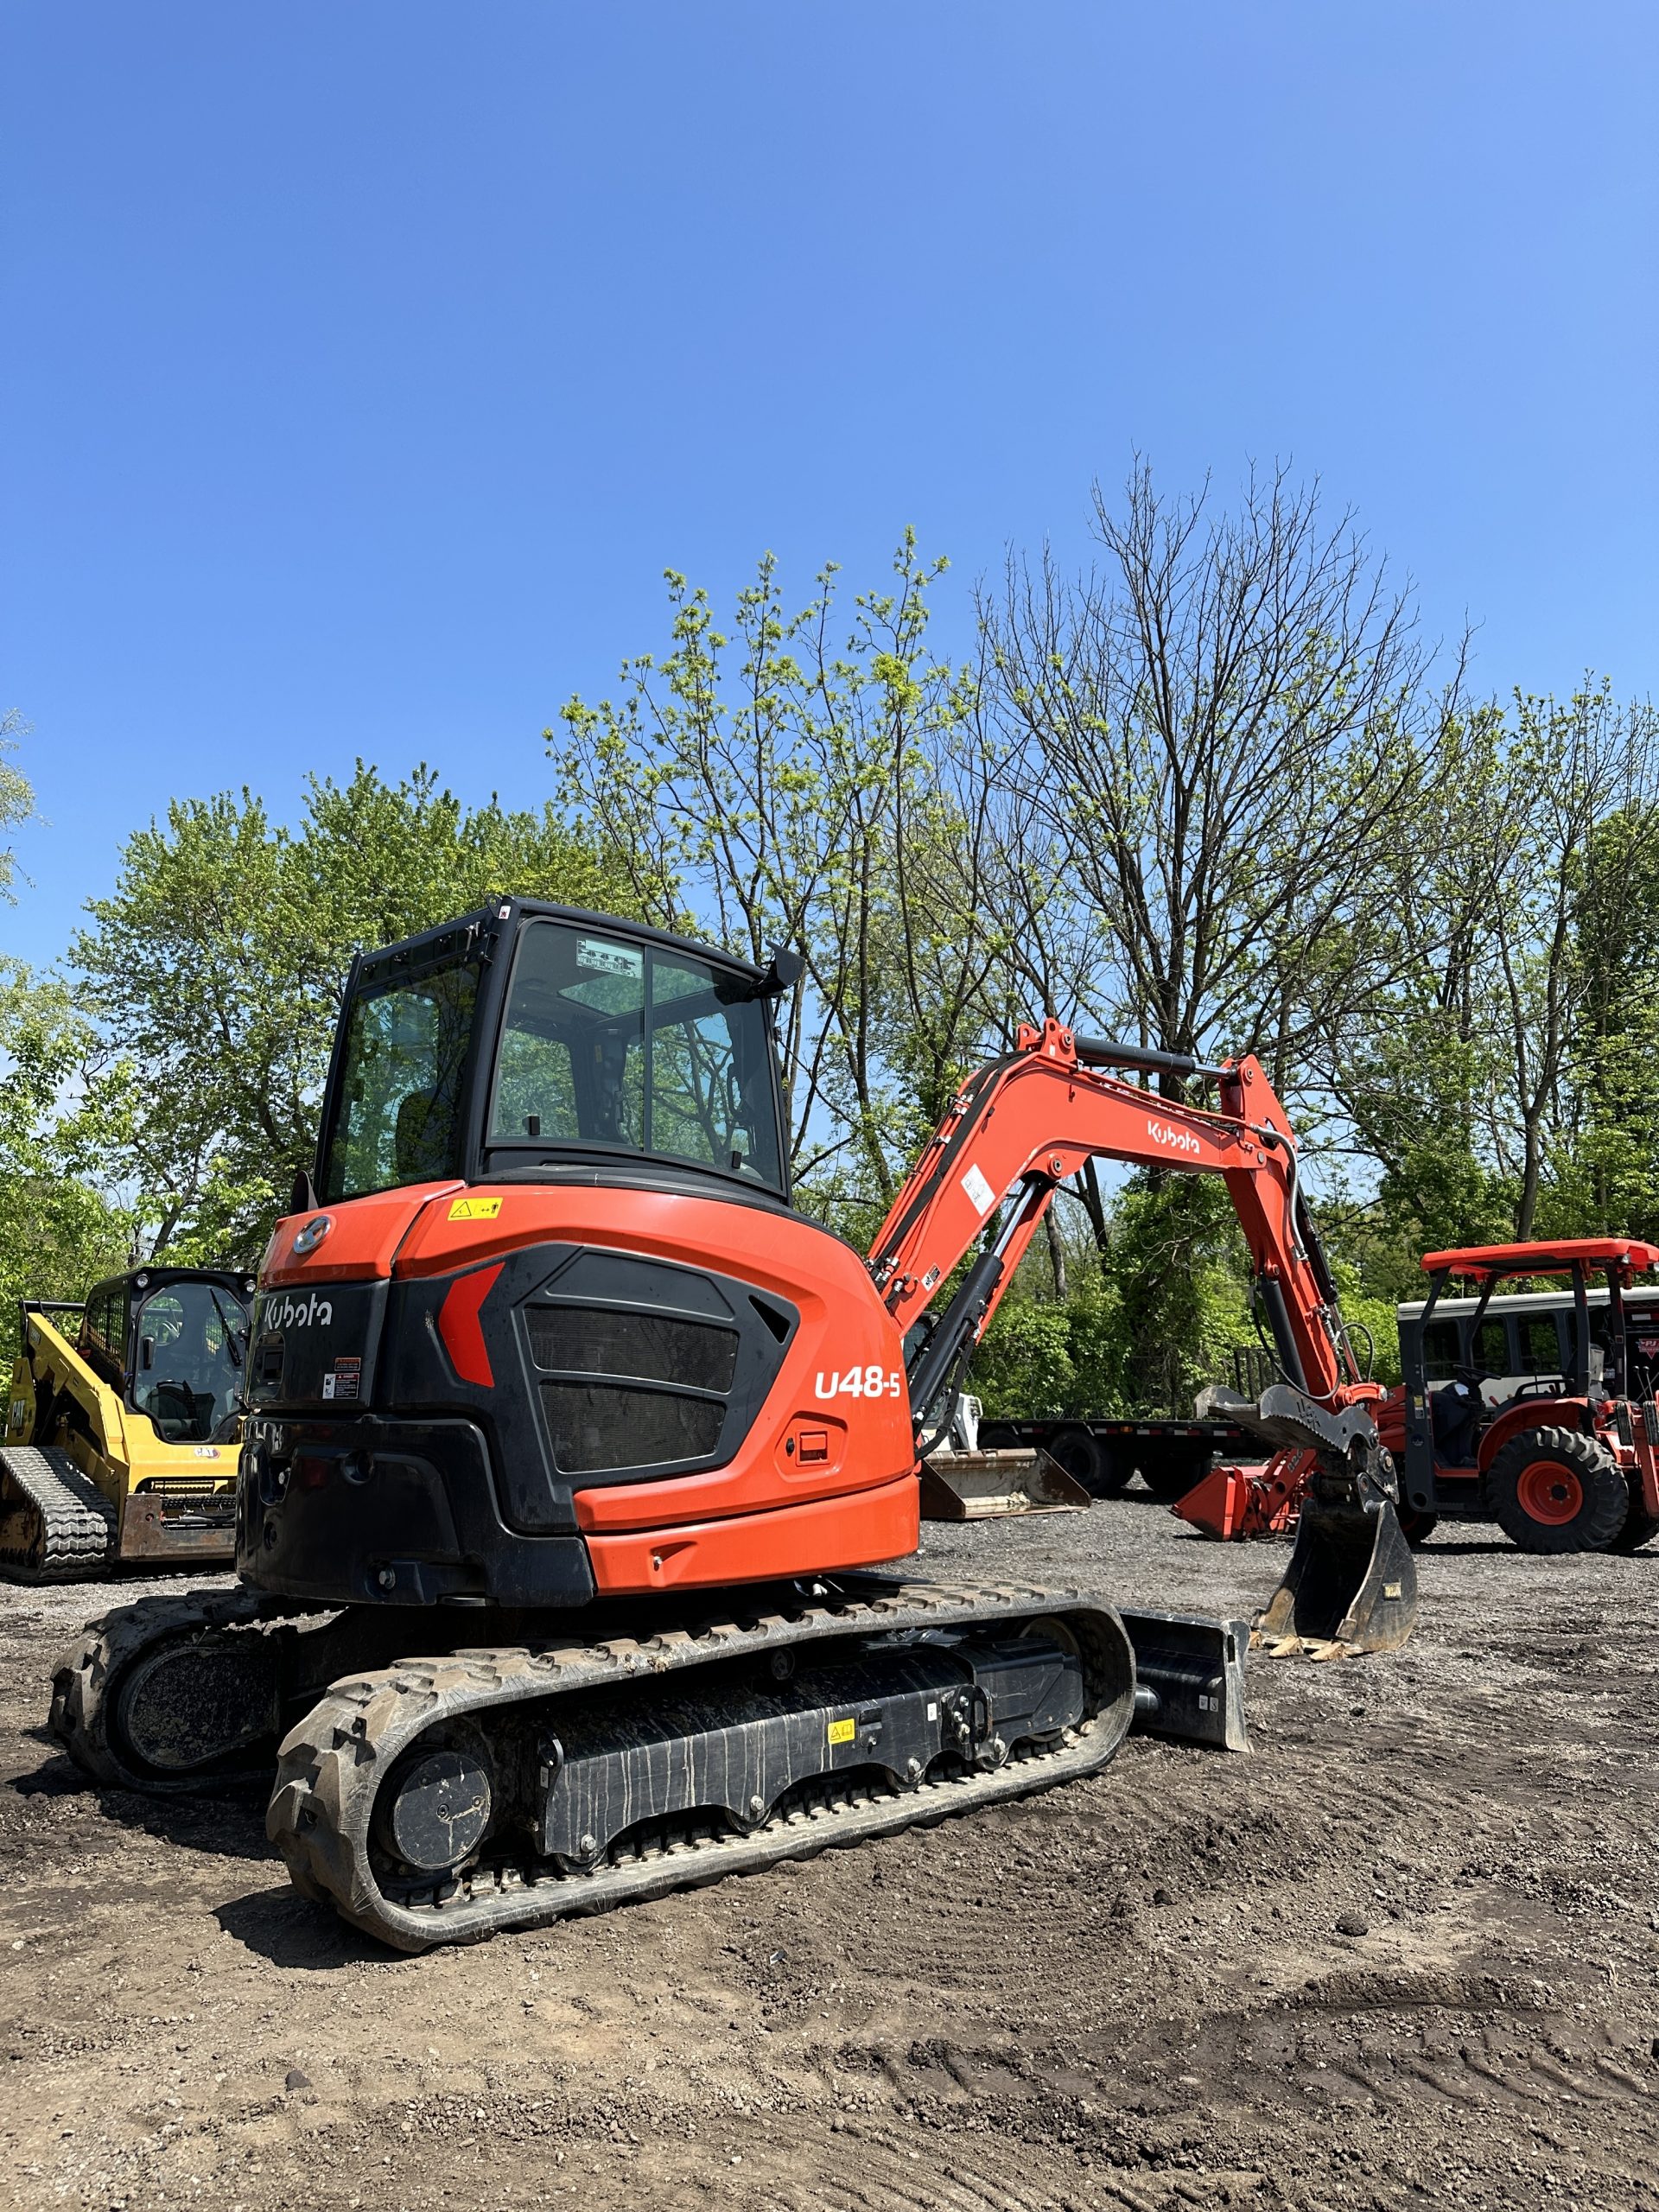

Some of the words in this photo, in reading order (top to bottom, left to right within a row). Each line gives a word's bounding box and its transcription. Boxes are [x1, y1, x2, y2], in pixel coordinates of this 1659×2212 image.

[1147, 1120, 1200, 1154] Kubota
[264, 1293, 333, 1330] Kubota
[815, 1365, 900, 1399] U48-5
[11, 1399, 25, 1429] CAT
